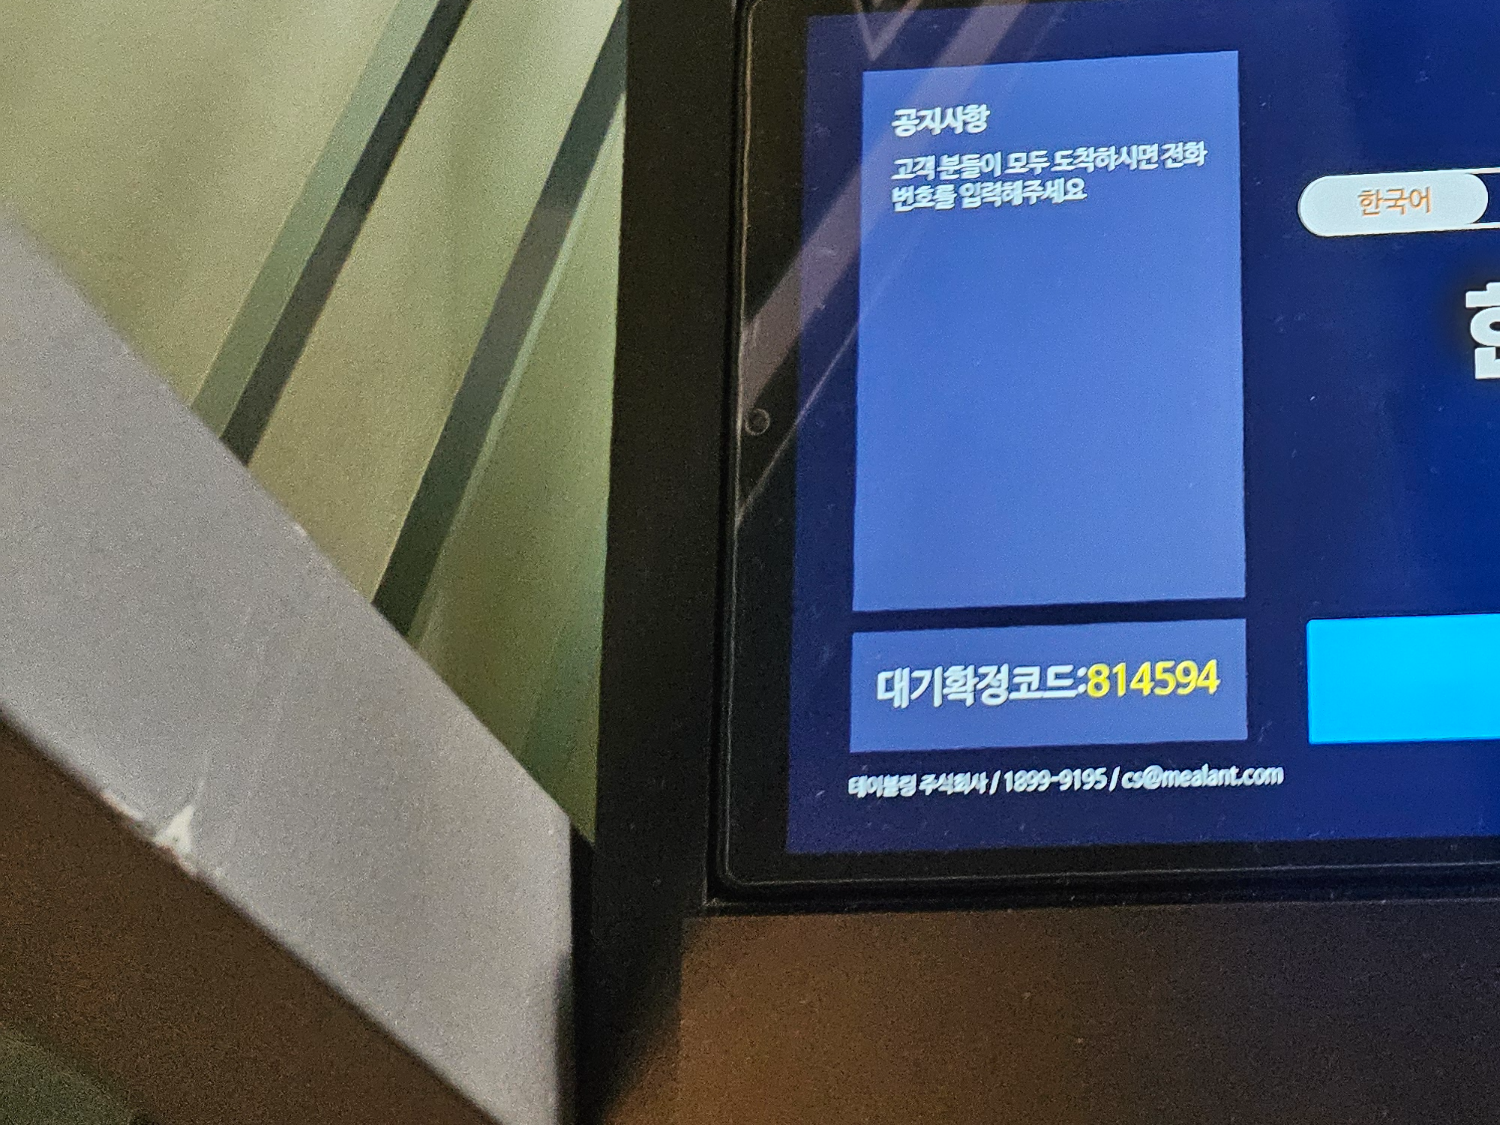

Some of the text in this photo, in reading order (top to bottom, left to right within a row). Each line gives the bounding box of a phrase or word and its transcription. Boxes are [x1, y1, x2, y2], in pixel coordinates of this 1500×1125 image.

[892, 104, 991, 137] 공지사항
[891, 140, 1208, 181] 고객 분들이 모두 도착하시면 전화
[891, 177, 1088, 212] 번호를 입력해주세요
[1357, 187, 1432, 217] 한국어
[848, 763, 1285, 798] 테이블링 주식회사 / 1899-9195 / cs@mealant.com
